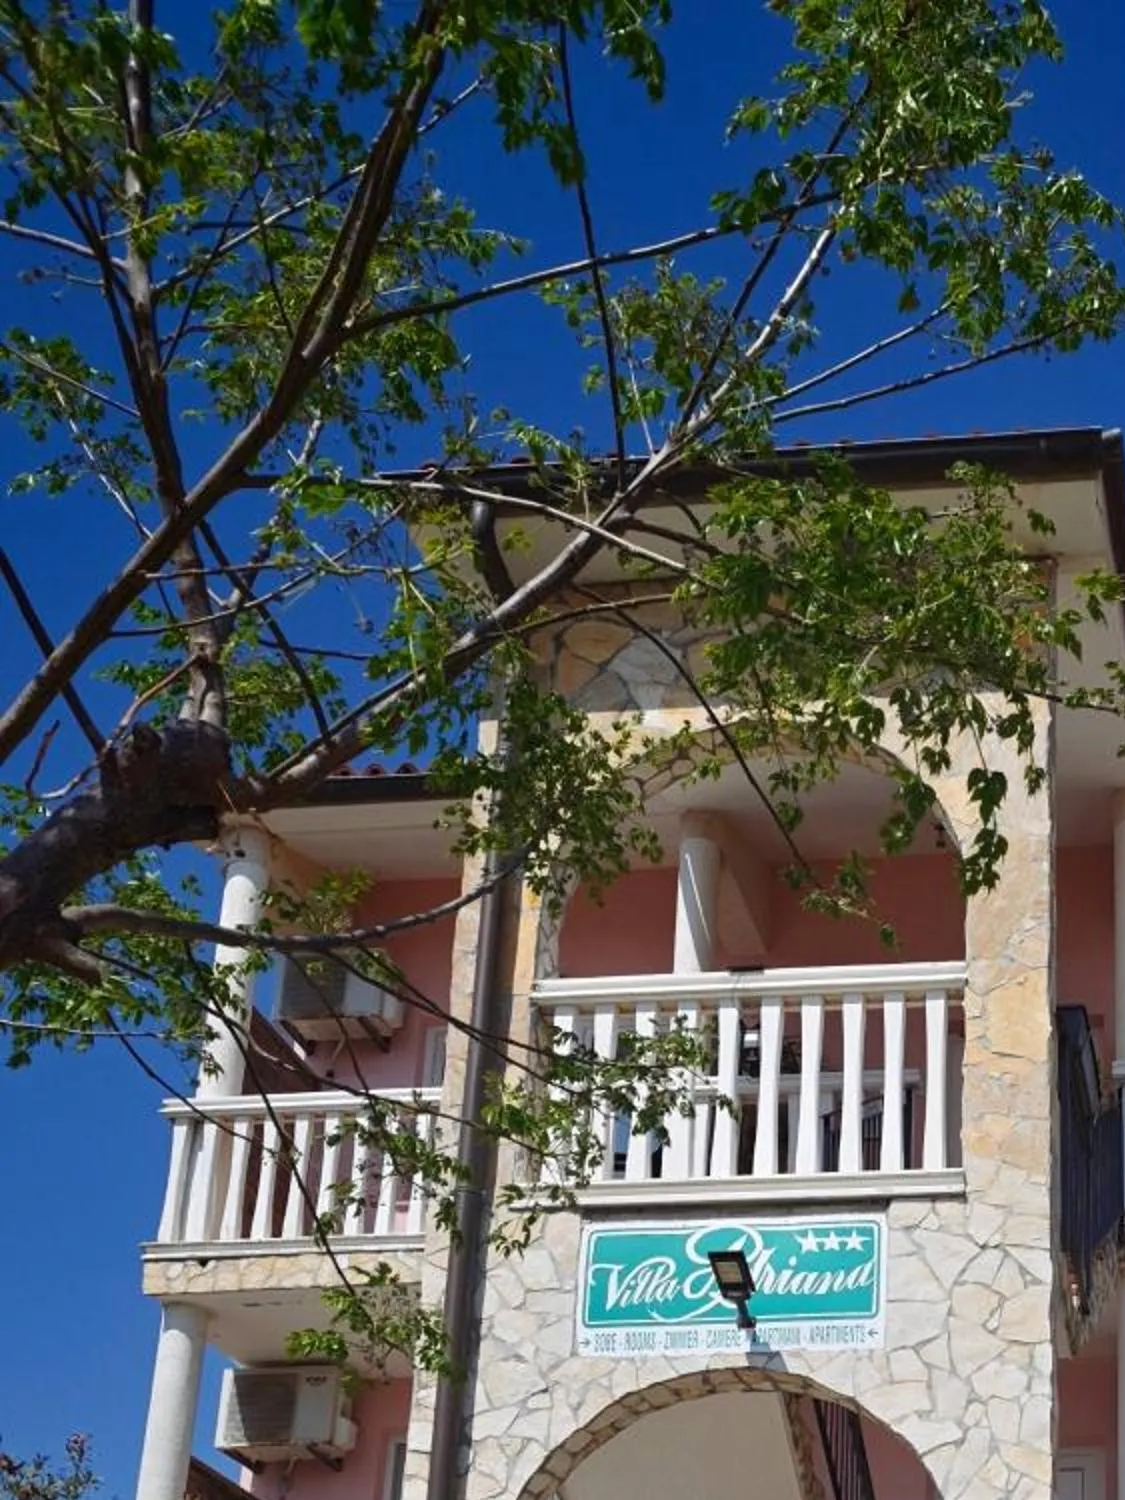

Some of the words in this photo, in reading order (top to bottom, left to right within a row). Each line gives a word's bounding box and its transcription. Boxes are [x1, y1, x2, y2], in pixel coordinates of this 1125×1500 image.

[590, 1256, 681, 1312] Villa
[624, 1330, 656, 1352] ROOMS
[663, 1329, 698, 1350] ZIMMER
[755, 1326, 801, 1347] PARTMANI
[809, 1323, 866, 1345] APARTMENTS
